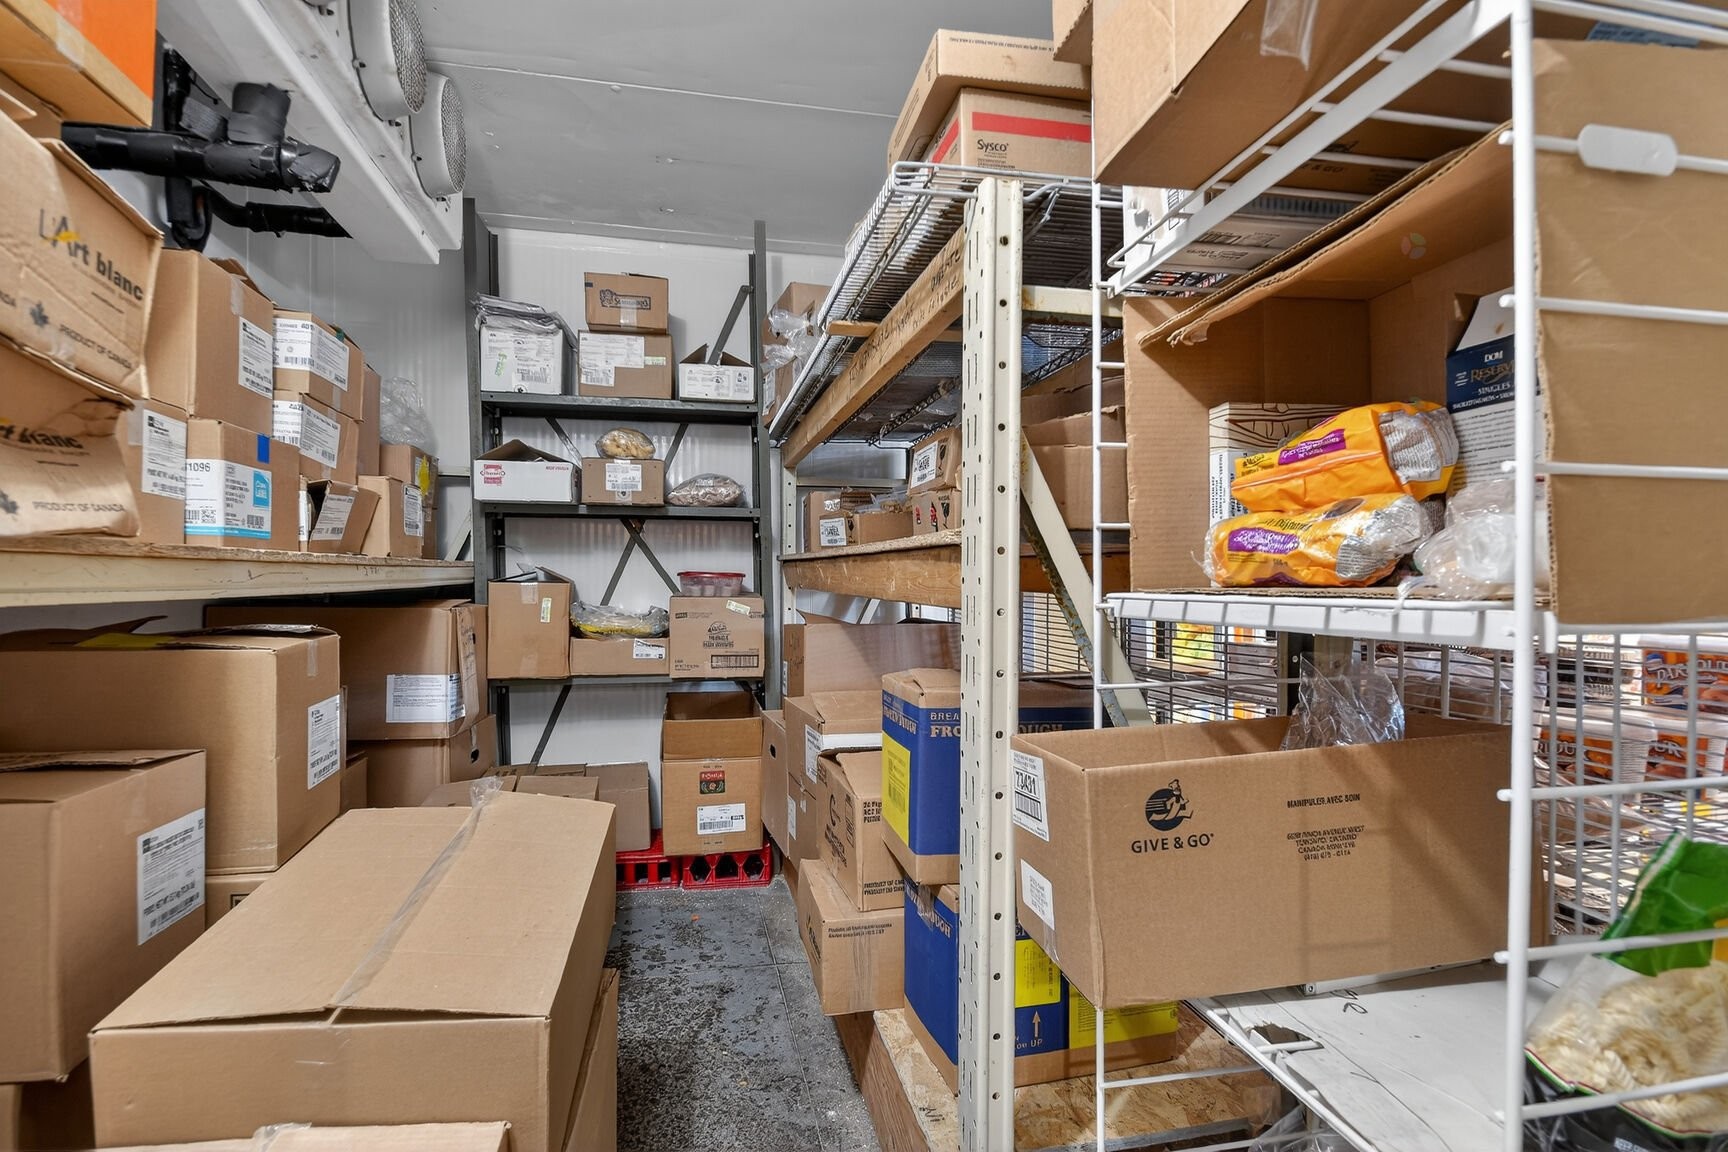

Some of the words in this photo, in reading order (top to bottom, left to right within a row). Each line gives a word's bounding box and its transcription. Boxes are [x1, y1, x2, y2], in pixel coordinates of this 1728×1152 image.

[977, 139, 1006, 152] Sysco
[95, 252, 144, 301] blanc
[930, 711, 961, 721] BREA
[930, 725, 961, 738] FRO
[1018, 724, 1063, 734] OUGH
[1131, 838, 1169, 854] GIVE
[1173, 837, 1184, 850] &
[1187, 834, 1211, 848] GO
[1030, 1039, 1043, 1048] UP
